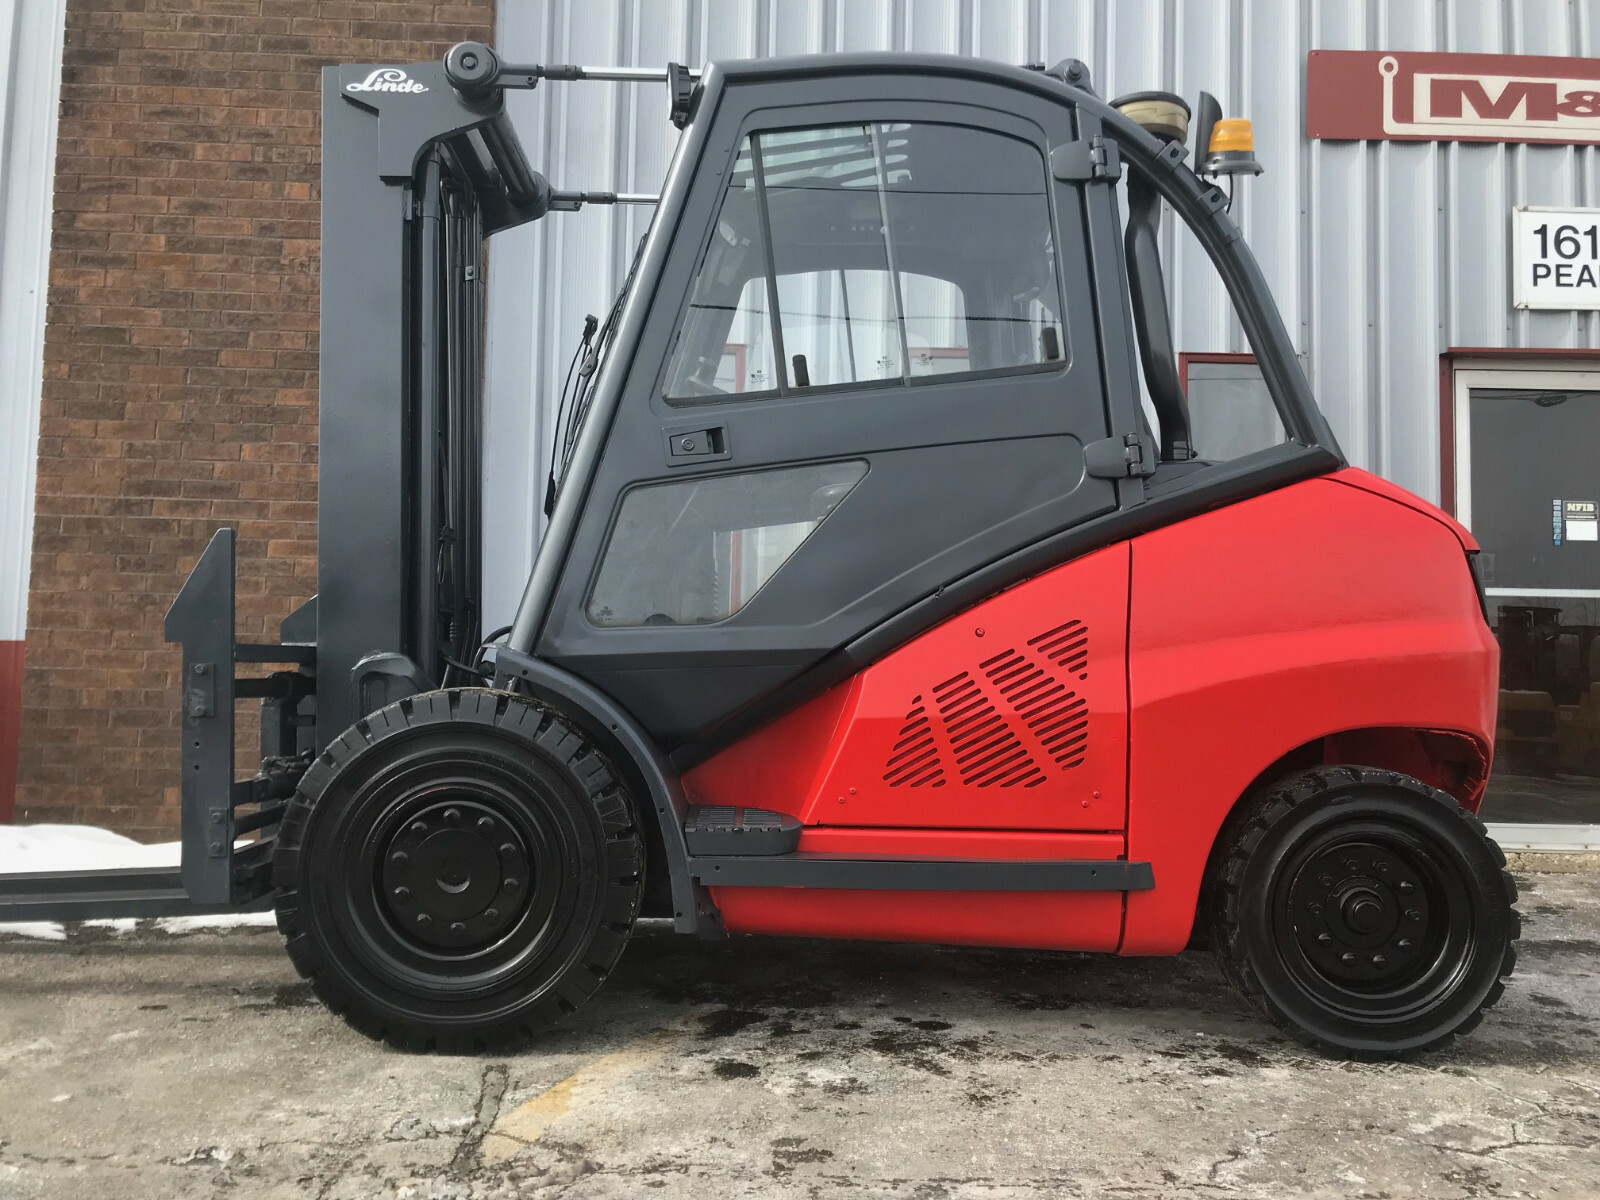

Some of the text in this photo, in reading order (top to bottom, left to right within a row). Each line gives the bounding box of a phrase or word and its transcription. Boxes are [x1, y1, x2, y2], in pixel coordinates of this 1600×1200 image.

[346, 68, 429, 93] Linde
[1533, 224, 1598, 260] 161
[1533, 264, 1600, 288] PEA
